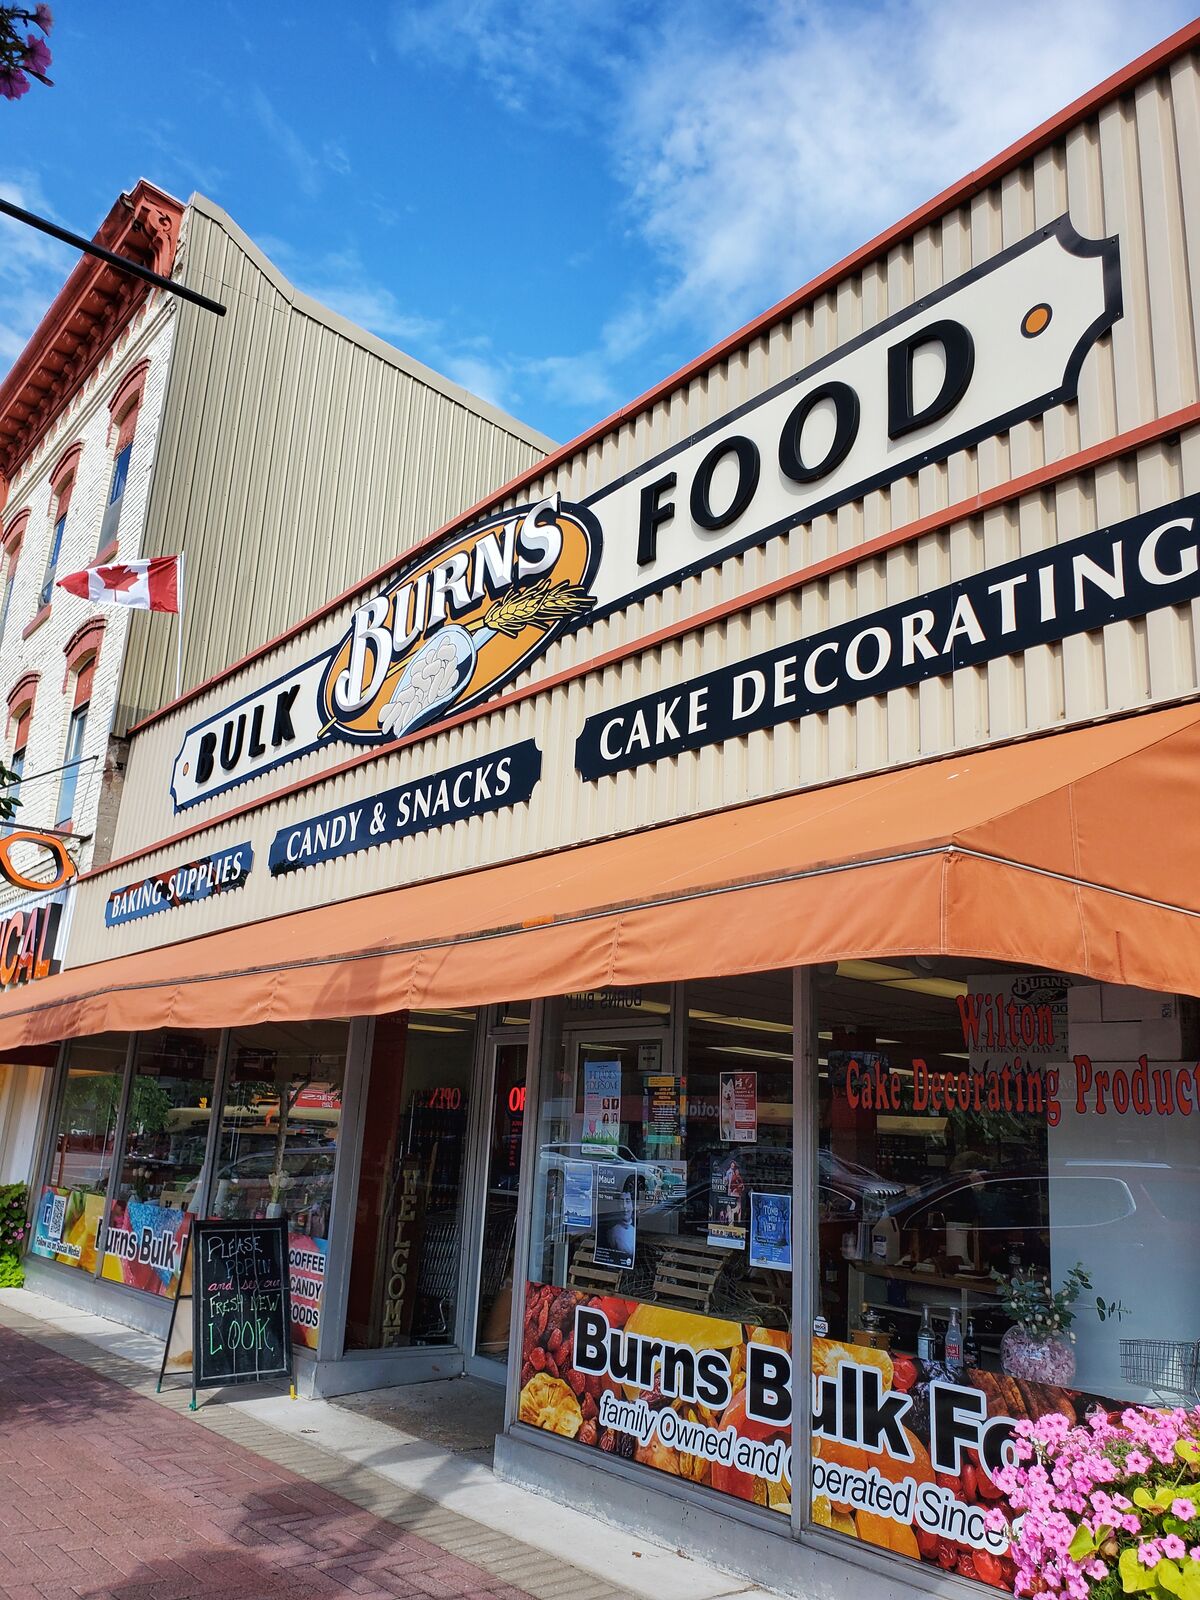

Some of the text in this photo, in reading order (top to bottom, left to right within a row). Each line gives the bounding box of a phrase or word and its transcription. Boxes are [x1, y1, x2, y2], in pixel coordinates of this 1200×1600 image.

[637, 319, 975, 566] FOOD
[334, 492, 563, 712] BURNS
[599, 517, 1199, 760] CAKE DECORATING
[195, 684, 300, 797] BULK
[286, 757, 512, 863] CANDY & SNACKS
[111, 851, 243, 919] BAKING SUPPLIES
[956, 993, 1056, 1048] Wilton
[1012, 976, 1073, 995] BURNS
[846, 1059, 901, 1111] Cake
[911, 1057, 1062, 1127] Decorating
[140, 1228, 177, 1270] Bulk
[207, 1275, 235, 1292] and
[288, 1249, 325, 1272] COFFEE
[384, 1170, 420, 1347] WELCOME
[289, 1276, 322, 1299] CANDY
[207, 1317, 274, 1355] LOOK
[576, 1310, 729, 1406] Burns
[659, 1412, 734, 1461] Owned
[737, 1444, 782, 1476] and
[787, 1455, 912, 1517] perated
